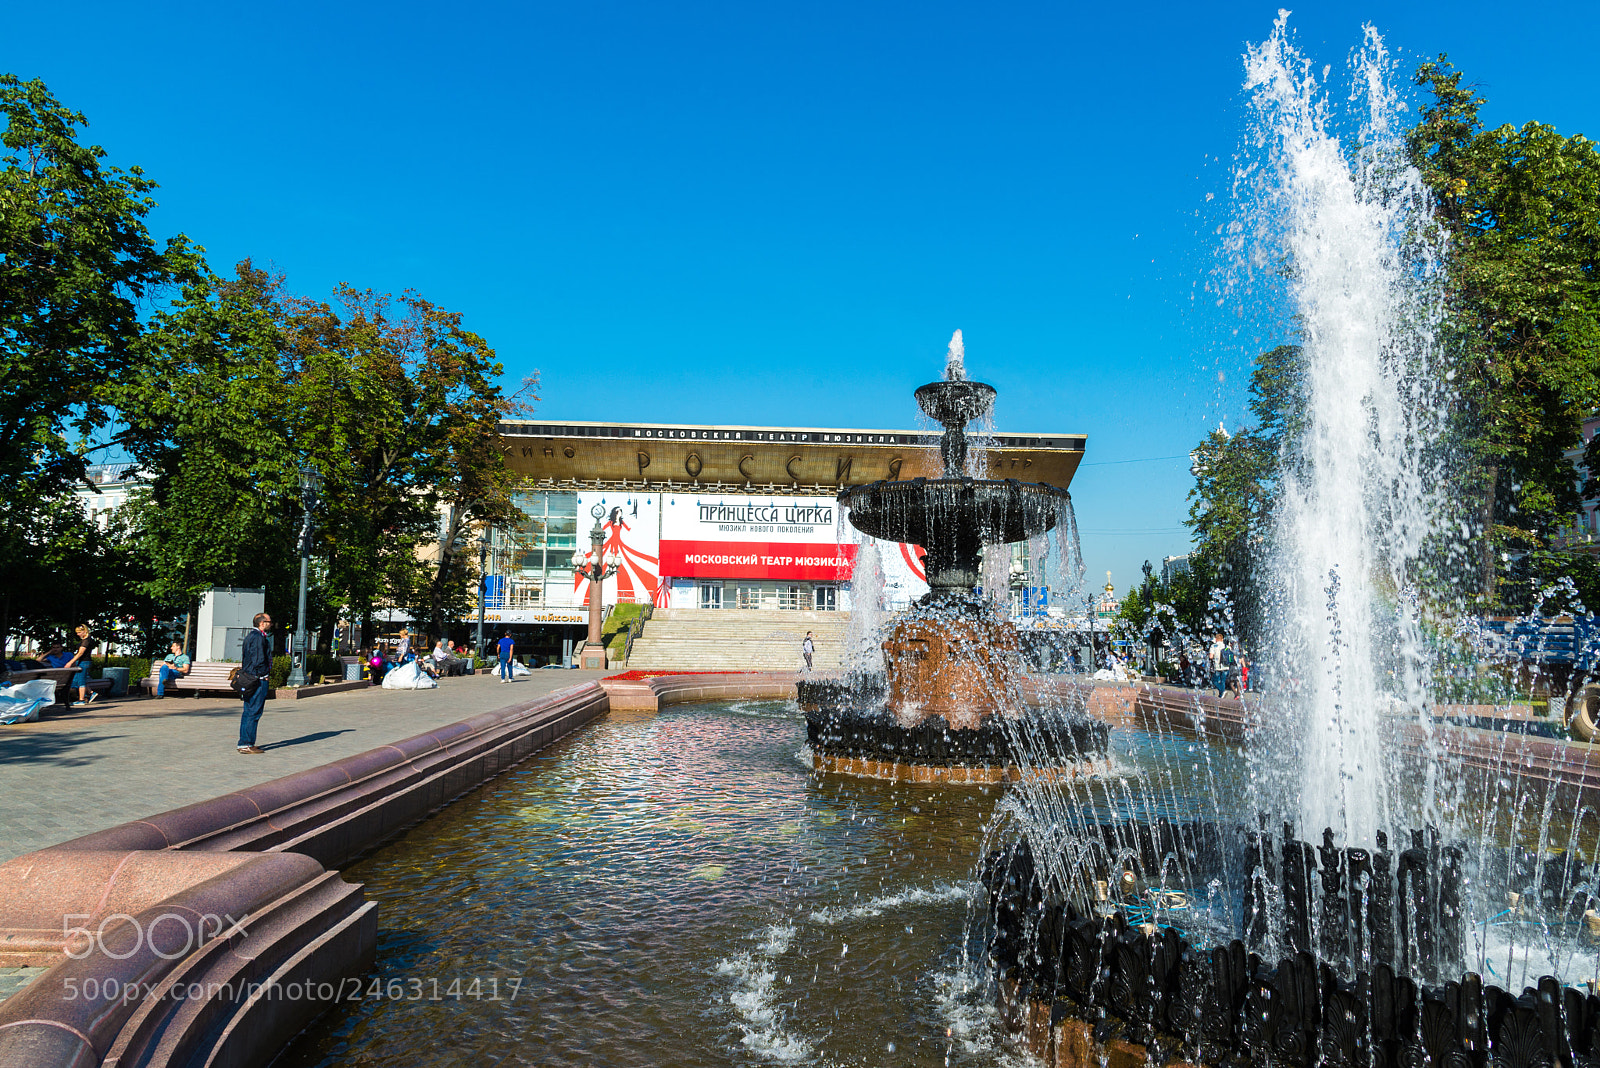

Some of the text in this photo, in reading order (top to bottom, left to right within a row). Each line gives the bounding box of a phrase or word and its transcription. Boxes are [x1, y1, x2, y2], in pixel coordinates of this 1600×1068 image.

[757, 433, 808, 441] ТЕАТР
[823, 434, 896, 443] МЮЗИКЛА
[501, 445, 576, 459] КИНО
[637, 451, 903, 482] РОССИЯ
[699, 505, 832, 524] ПРИНЦЕССА ЦИРКА
[718, 524, 747, 532] МЮЗИКЛ
[749, 525, 774, 533] НОВОГО
[685, 553, 849, 567] МОСКОВСКИЙ ТЕАТР МЮЗИКЛА
[533, 612, 583, 623] ЧАЙХОНА
